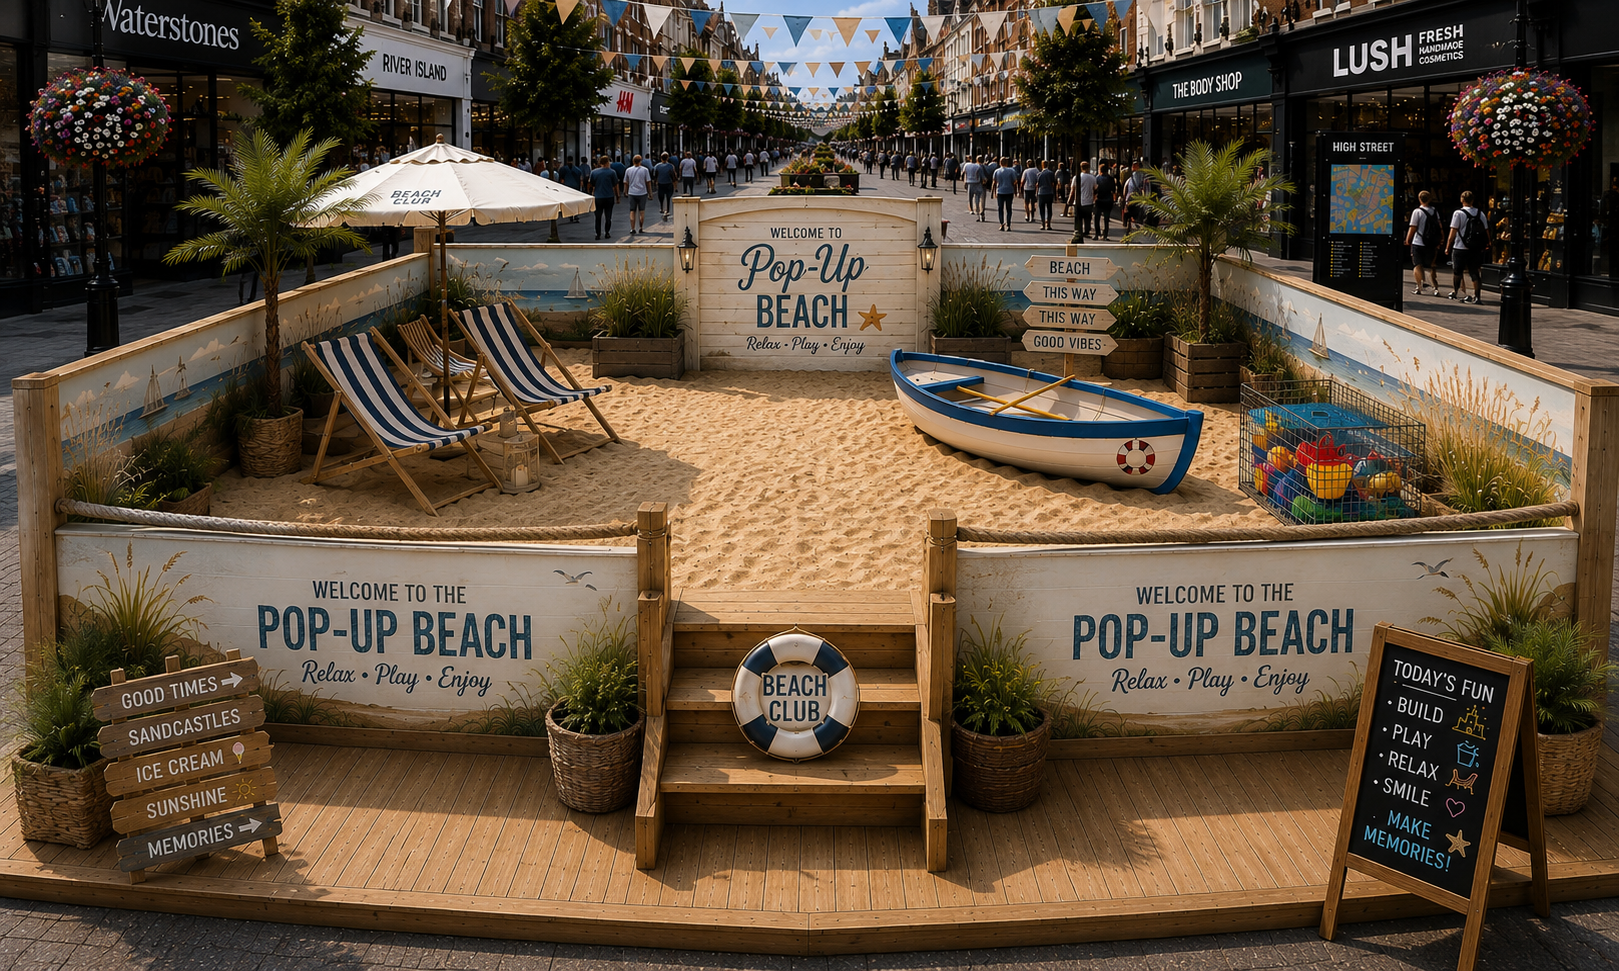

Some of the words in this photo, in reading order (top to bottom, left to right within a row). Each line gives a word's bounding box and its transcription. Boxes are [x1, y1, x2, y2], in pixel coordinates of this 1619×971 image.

[1419, 24, 1463, 44] FRESH
[383, 53, 411, 76] RIVER
[415, 60, 446, 81] ISLAND
[1333, 34, 1412, 77] LUSH
[1419, 51, 1463, 65] COSMETICS
[1172, 82, 1189, 99] THE
[1190, 76, 1214, 96] BODY
[1215, 71, 1242, 93] SHOP
[1333, 142, 1356, 152] HIGH
[1360, 142, 1394, 152] STREET
[390, 190, 441, 199] BEACH
[770, 227, 824, 239] WELCOME
[828, 227, 842, 239] TO
[737, 243, 869, 293] Pop-Up
[1049, 261, 1090, 275] BEACH
[1043, 286, 1068, 299] THIS
[1071, 287, 1097, 301] WAY
[756, 294, 848, 329] BEACH
[1039, 310, 1066, 324] THIS
[1070, 312, 1096, 325] WAY
[746, 336, 781, 351] Relax
[791, 336, 820, 354] Play
[831, 337, 866, 354] Enjoy
[1033, 335, 1065, 348] GOOD
[1069, 337, 1102, 351] VIBES
[312, 580, 399, 602] WELCOME
[404, 584, 426, 602] TO
[433, 585, 467, 604] THE
[1136, 585, 1226, 605] WELCOME
[1232, 584, 1255, 603] TO
[1261, 583, 1294, 602] THE
[257, 604, 398, 654] POP-UP
[412, 610, 533, 660] BEACH
[1072, 611, 1219, 660] POP-UP
[1233, 608, 1354, 656] BEACH
[121, 686, 165, 709] GOOD
[169, 676, 218, 700] TIMES
[301, 659, 356, 686] Relax
[374, 662, 420, 694] Play
[437, 665, 493, 698] Enjoy
[763, 674, 827, 696] BEACH
[1111, 667, 1168, 695] Relax
[1187, 666, 1234, 697] Play
[1253, 664, 1310, 695] Enjoy
[1394, 659, 1457, 692] TODAY'S
[1461, 678, 1495, 704] FUN
[769, 700, 820, 721] CLUB
[1397, 696, 1444, 724] BUILD
[128, 708, 241, 746] SANDCASTLES
[1392, 724, 1433, 750] PLAY
[136, 762, 163, 783] ICE
[168, 749, 224, 775] CREAM
[1387, 750, 1440, 781] RELAX
[146, 786, 228, 819] SUNSHINE
[1382, 777, 1432, 807] SMILE
[1387, 809, 1432, 840] MAKE
[147, 822, 234, 859] MEMORIES
[1364, 825, 1451, 872] MEMORIES!
